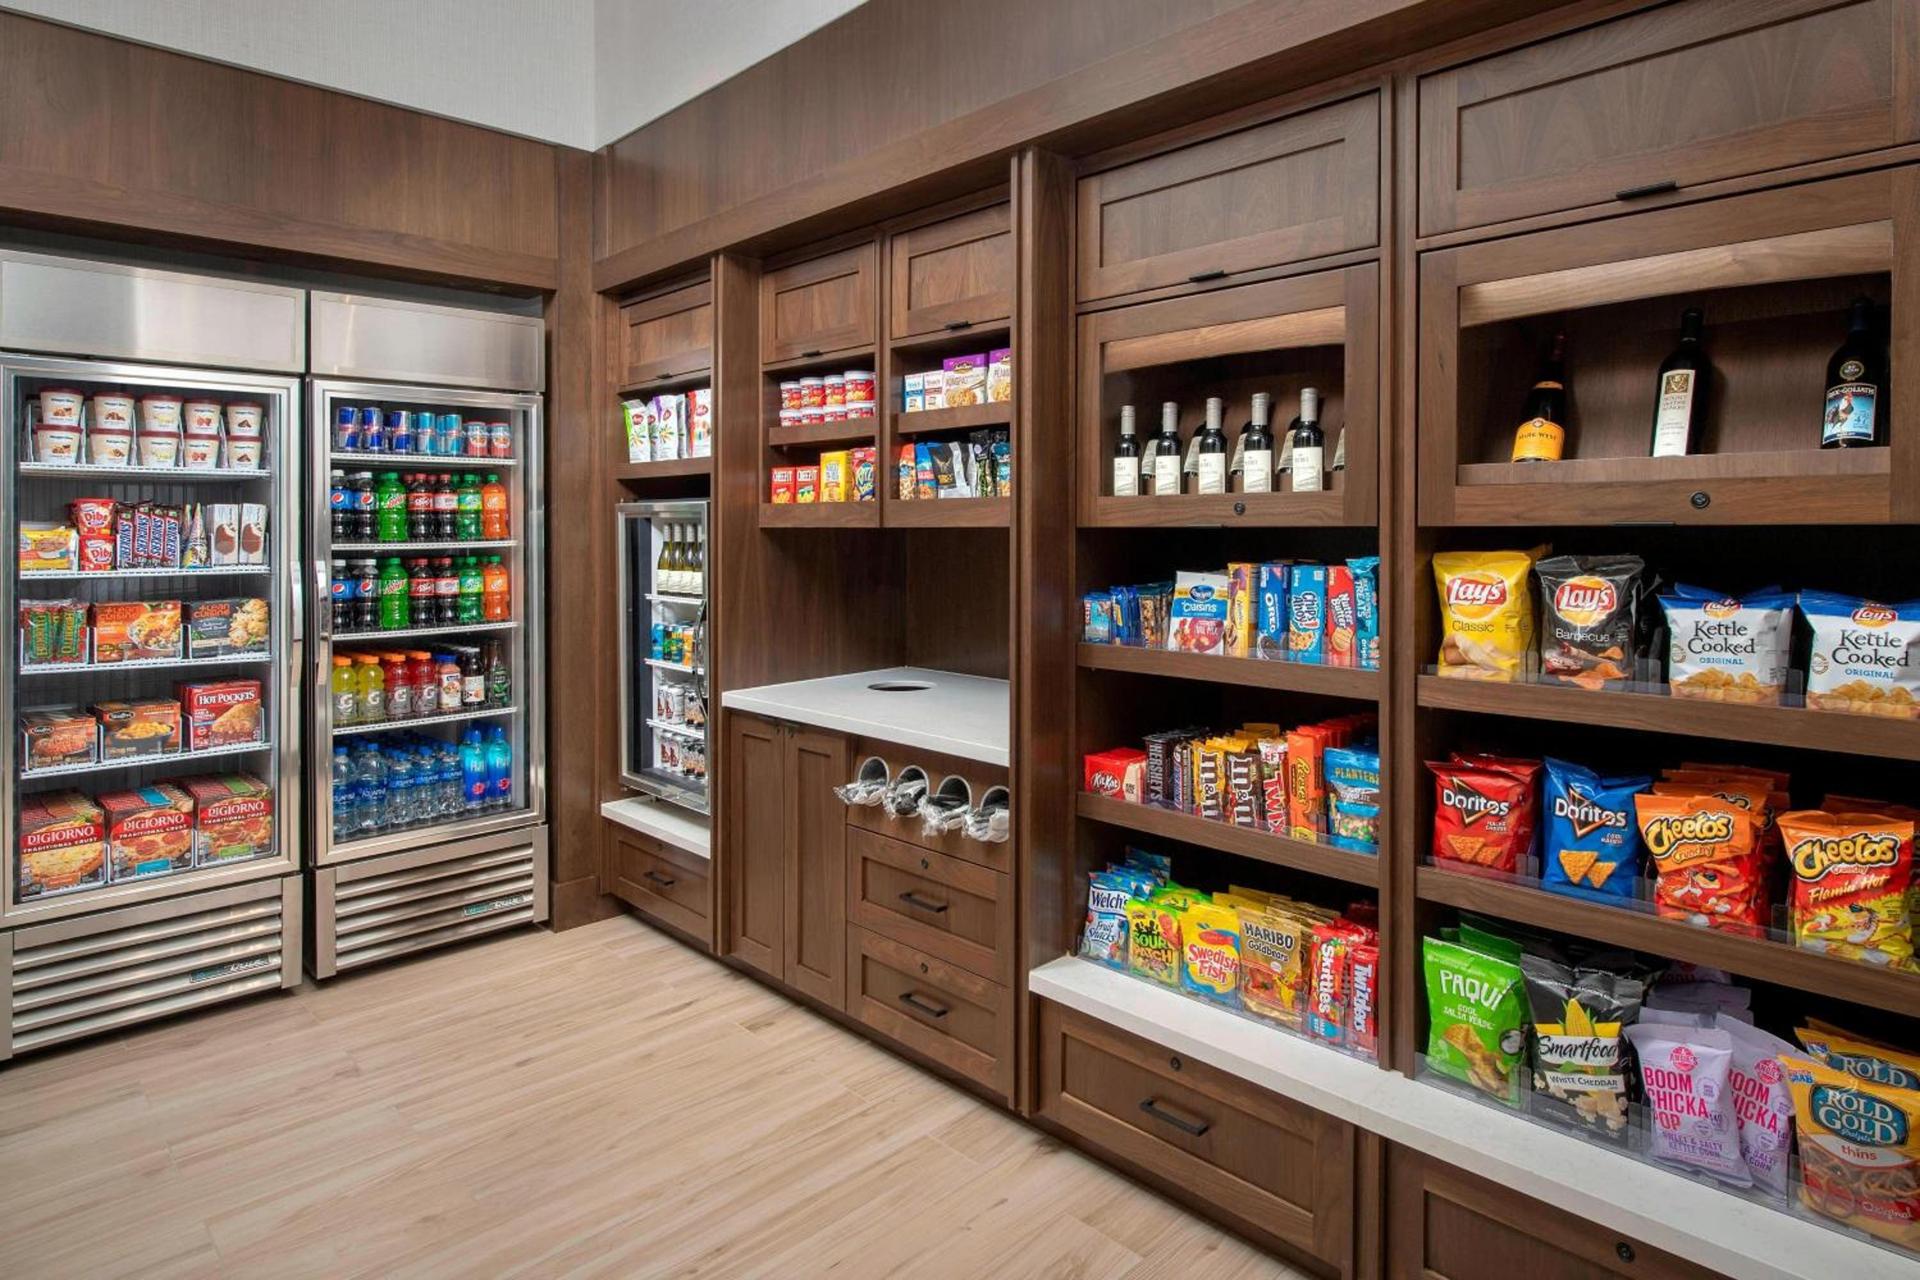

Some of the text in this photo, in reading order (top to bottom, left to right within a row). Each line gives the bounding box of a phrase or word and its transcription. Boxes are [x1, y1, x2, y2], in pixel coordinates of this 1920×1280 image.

[1448, 575, 1504, 606] Lay's
[1559, 584, 1612, 614] Lay's
[1265, 592, 1276, 633] OREO
[1452, 620, 1496, 633] Classic
[1555, 627, 1611, 644] Barbecue
[1693, 620, 1748, 641] Kettle
[1687, 637, 1757, 656] Cooked
[1840, 629, 1903, 649] Kettle
[1698, 656, 1745, 666] ORIGINAL
[1831, 647, 1910, 669] Cooked
[1844, 667, 1896, 680] ORIGINAL
[199, 690, 256, 704] HOT POCKETS
[339, 694, 353, 709] G
[367, 691, 381, 705] G
[395, 687, 407, 702] G
[423, 686, 436, 699] G
[1263, 771, 1287, 833] TWIX
[1442, 788, 1511, 816] Doritos
[1554, 797, 1627, 828] Doritos
[1644, 811, 1734, 859] Cheetos
[1792, 833, 1899, 881] Cheetos
[1857, 874, 1890, 891] Hot
[1091, 889, 1129, 910] Welch's
[1243, 921, 1294, 950] HARIBO
[1188, 943, 1239, 971] Swedish
[1247, 939, 1290, 963] Goldbears
[1198, 959, 1227, 984] Fish
[1318, 942, 1335, 1014] Skittles
[1439, 968, 1511, 1011] PAQUI
[1538, 1035, 1618, 1062] Smartfood
[1550, 1076, 1618, 1088] WHITE CHEDDAR
[1643, 1066, 1693, 1094] BOOM
[1842, 1056, 1907, 1088] ROLD
[1826, 1087, 1894, 1124] ROLD
[1818, 1105, 1898, 1145] GOLD
[1841, 1144, 1878, 1162] thins
